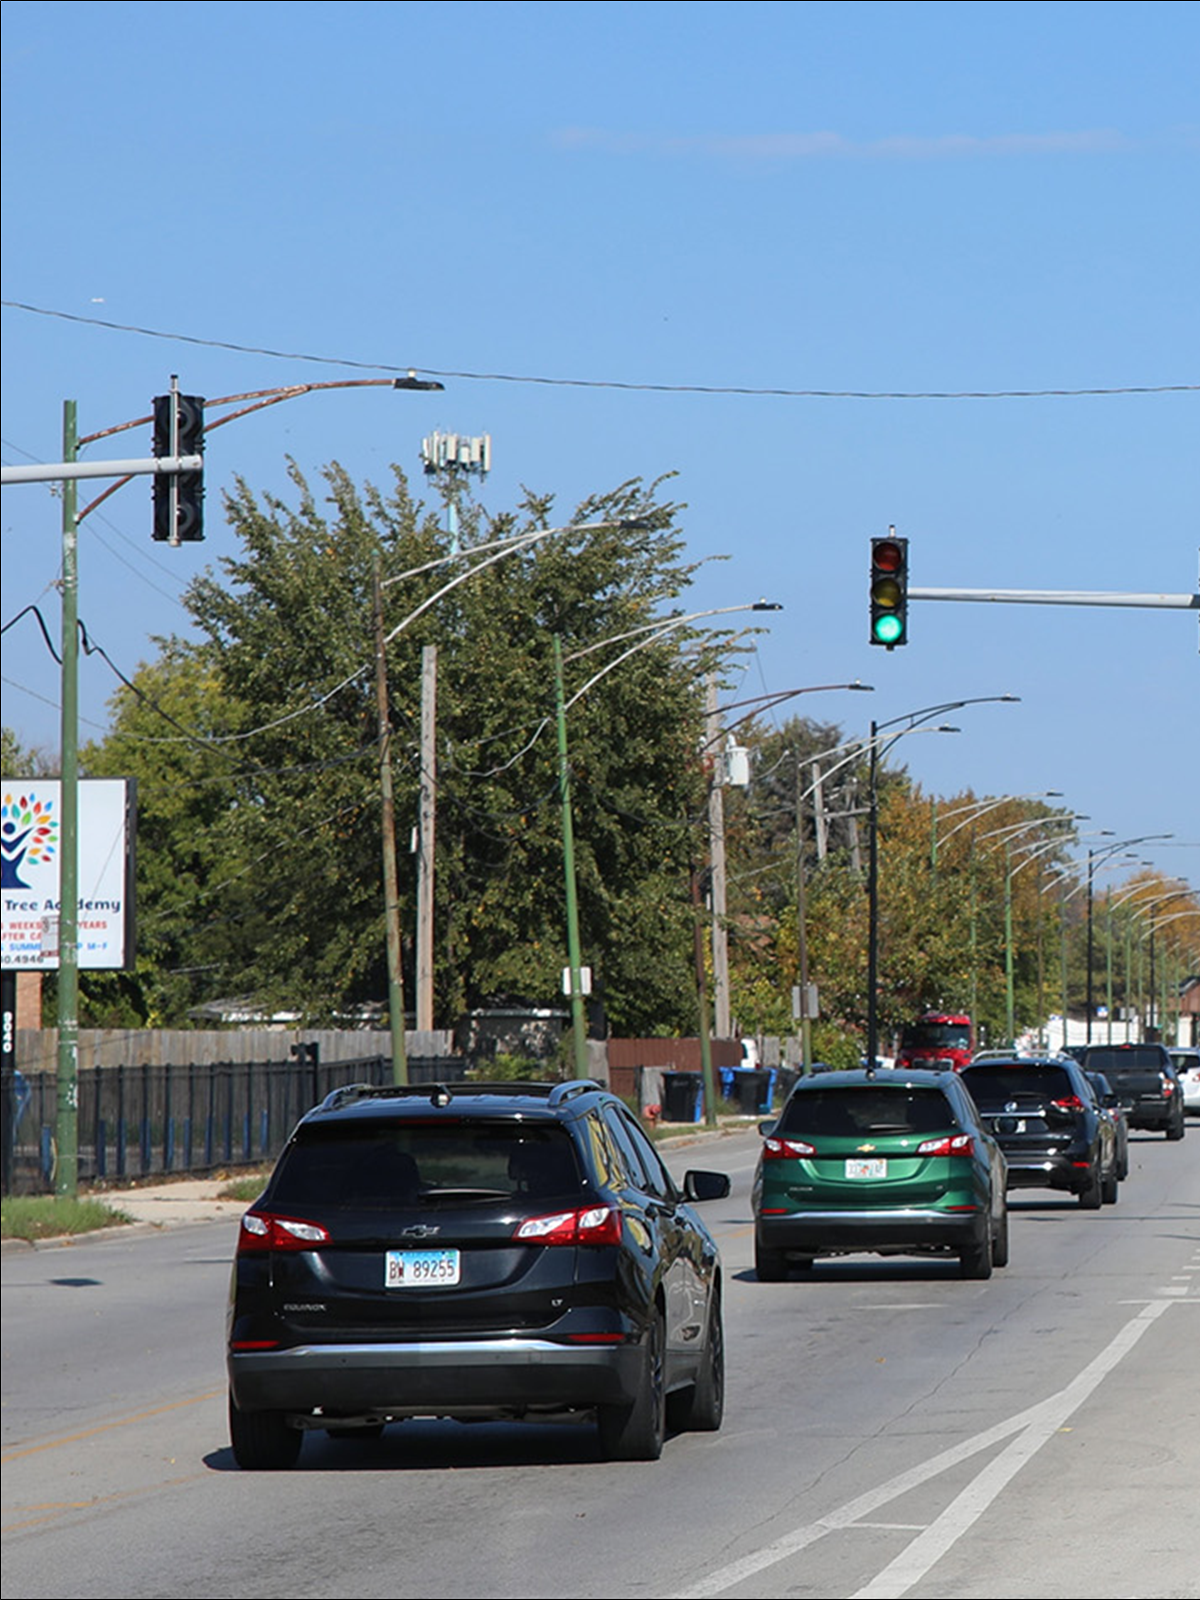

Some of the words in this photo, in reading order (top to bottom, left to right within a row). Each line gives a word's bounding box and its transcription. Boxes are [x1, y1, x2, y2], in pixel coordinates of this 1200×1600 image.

[5, 899, 38, 911] Tree
[44, 898, 121, 914] Acdemy
[78, 921, 107, 929] YEARS
[1, 932, 25, 940] FTER
[413, 1259, 455, 1279] 89255
